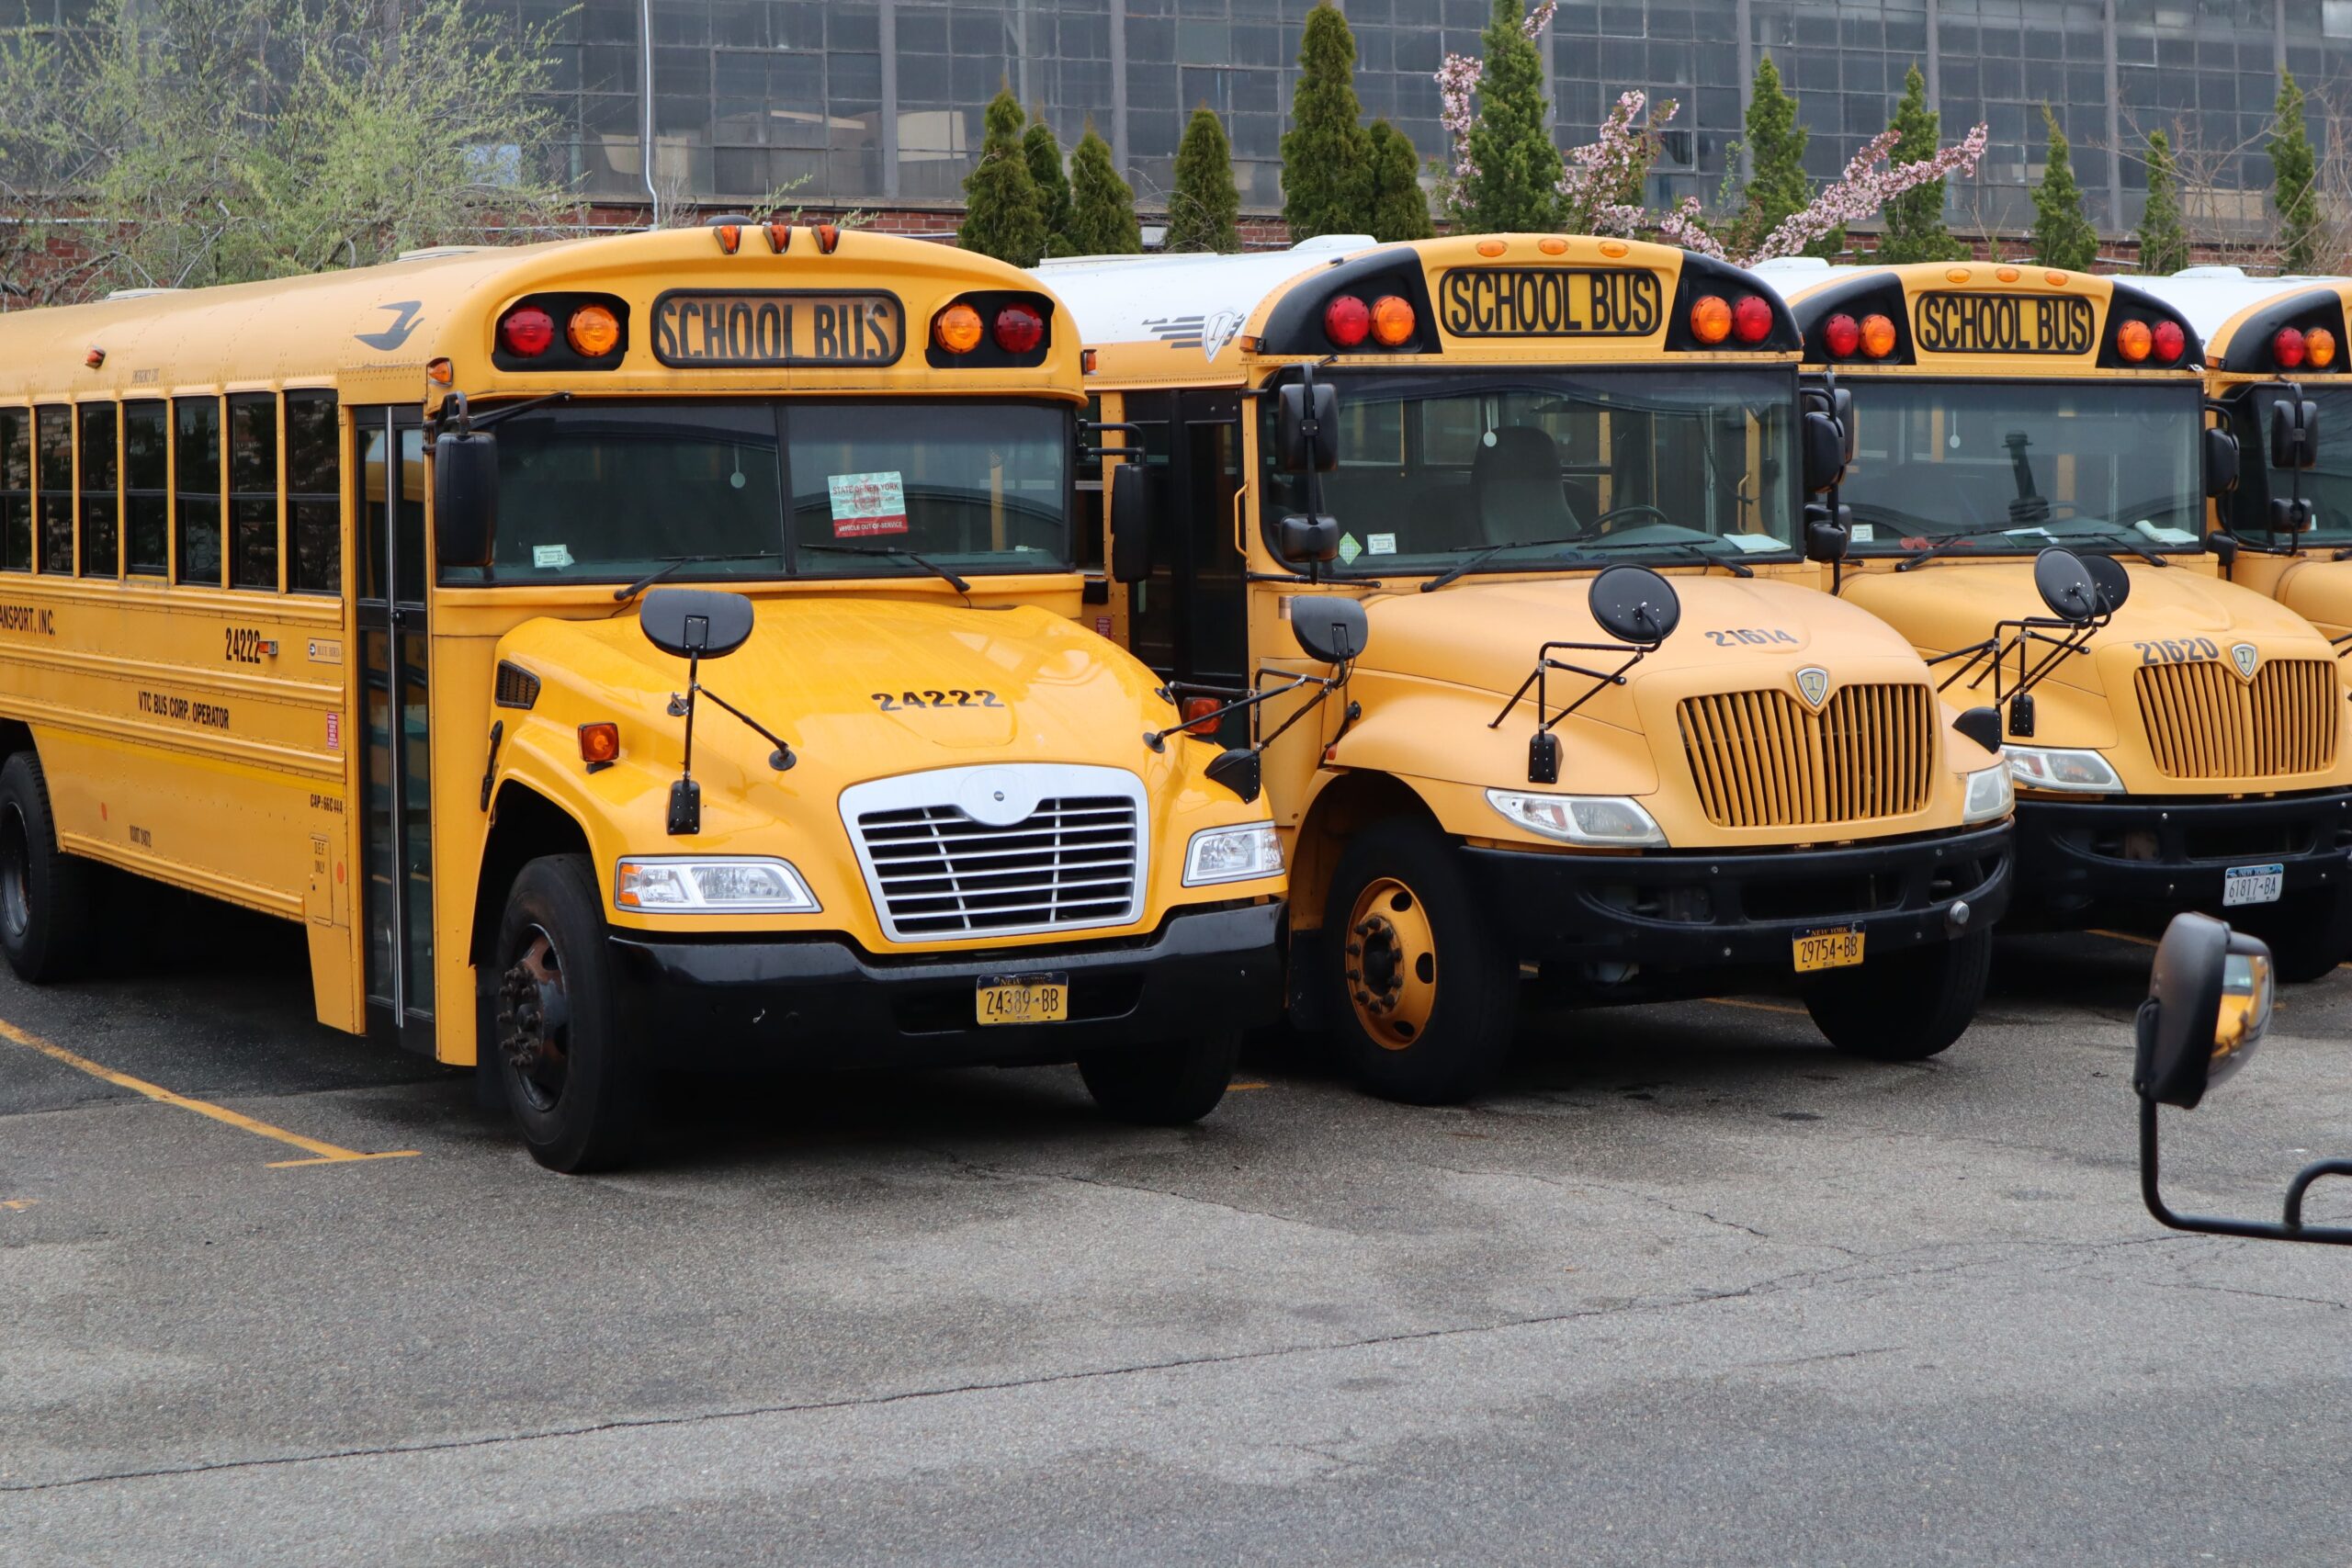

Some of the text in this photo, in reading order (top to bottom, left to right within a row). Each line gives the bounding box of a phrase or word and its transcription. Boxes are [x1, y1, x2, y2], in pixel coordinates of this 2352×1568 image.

[1451, 272, 1653, 332] SCHOOL BUS
[659, 301, 890, 359] SCHOOL BUS
[1925, 297, 2087, 350] SCHOOL BUS
[832, 485, 854, 495] STATE
[881, 482, 899, 491] YORK
[838, 524, 860, 532] VEHICLE
[38, 608, 56, 636] INC.
[225, 626, 261, 664] 24222
[1704, 628, 1799, 647] 21614
[2133, 637, 2220, 665] 21620
[138, 690, 230, 730] VTC BUS CORP. OPERATOR
[871, 690, 1005, 712] 24222
[2229, 876, 2276, 897] 61817 BA
[1812, 926, 1849, 937] NEW YORK
[1801, 936, 1858, 963] 29754 BB
[986, 987, 1058, 1015] 24389 BB
